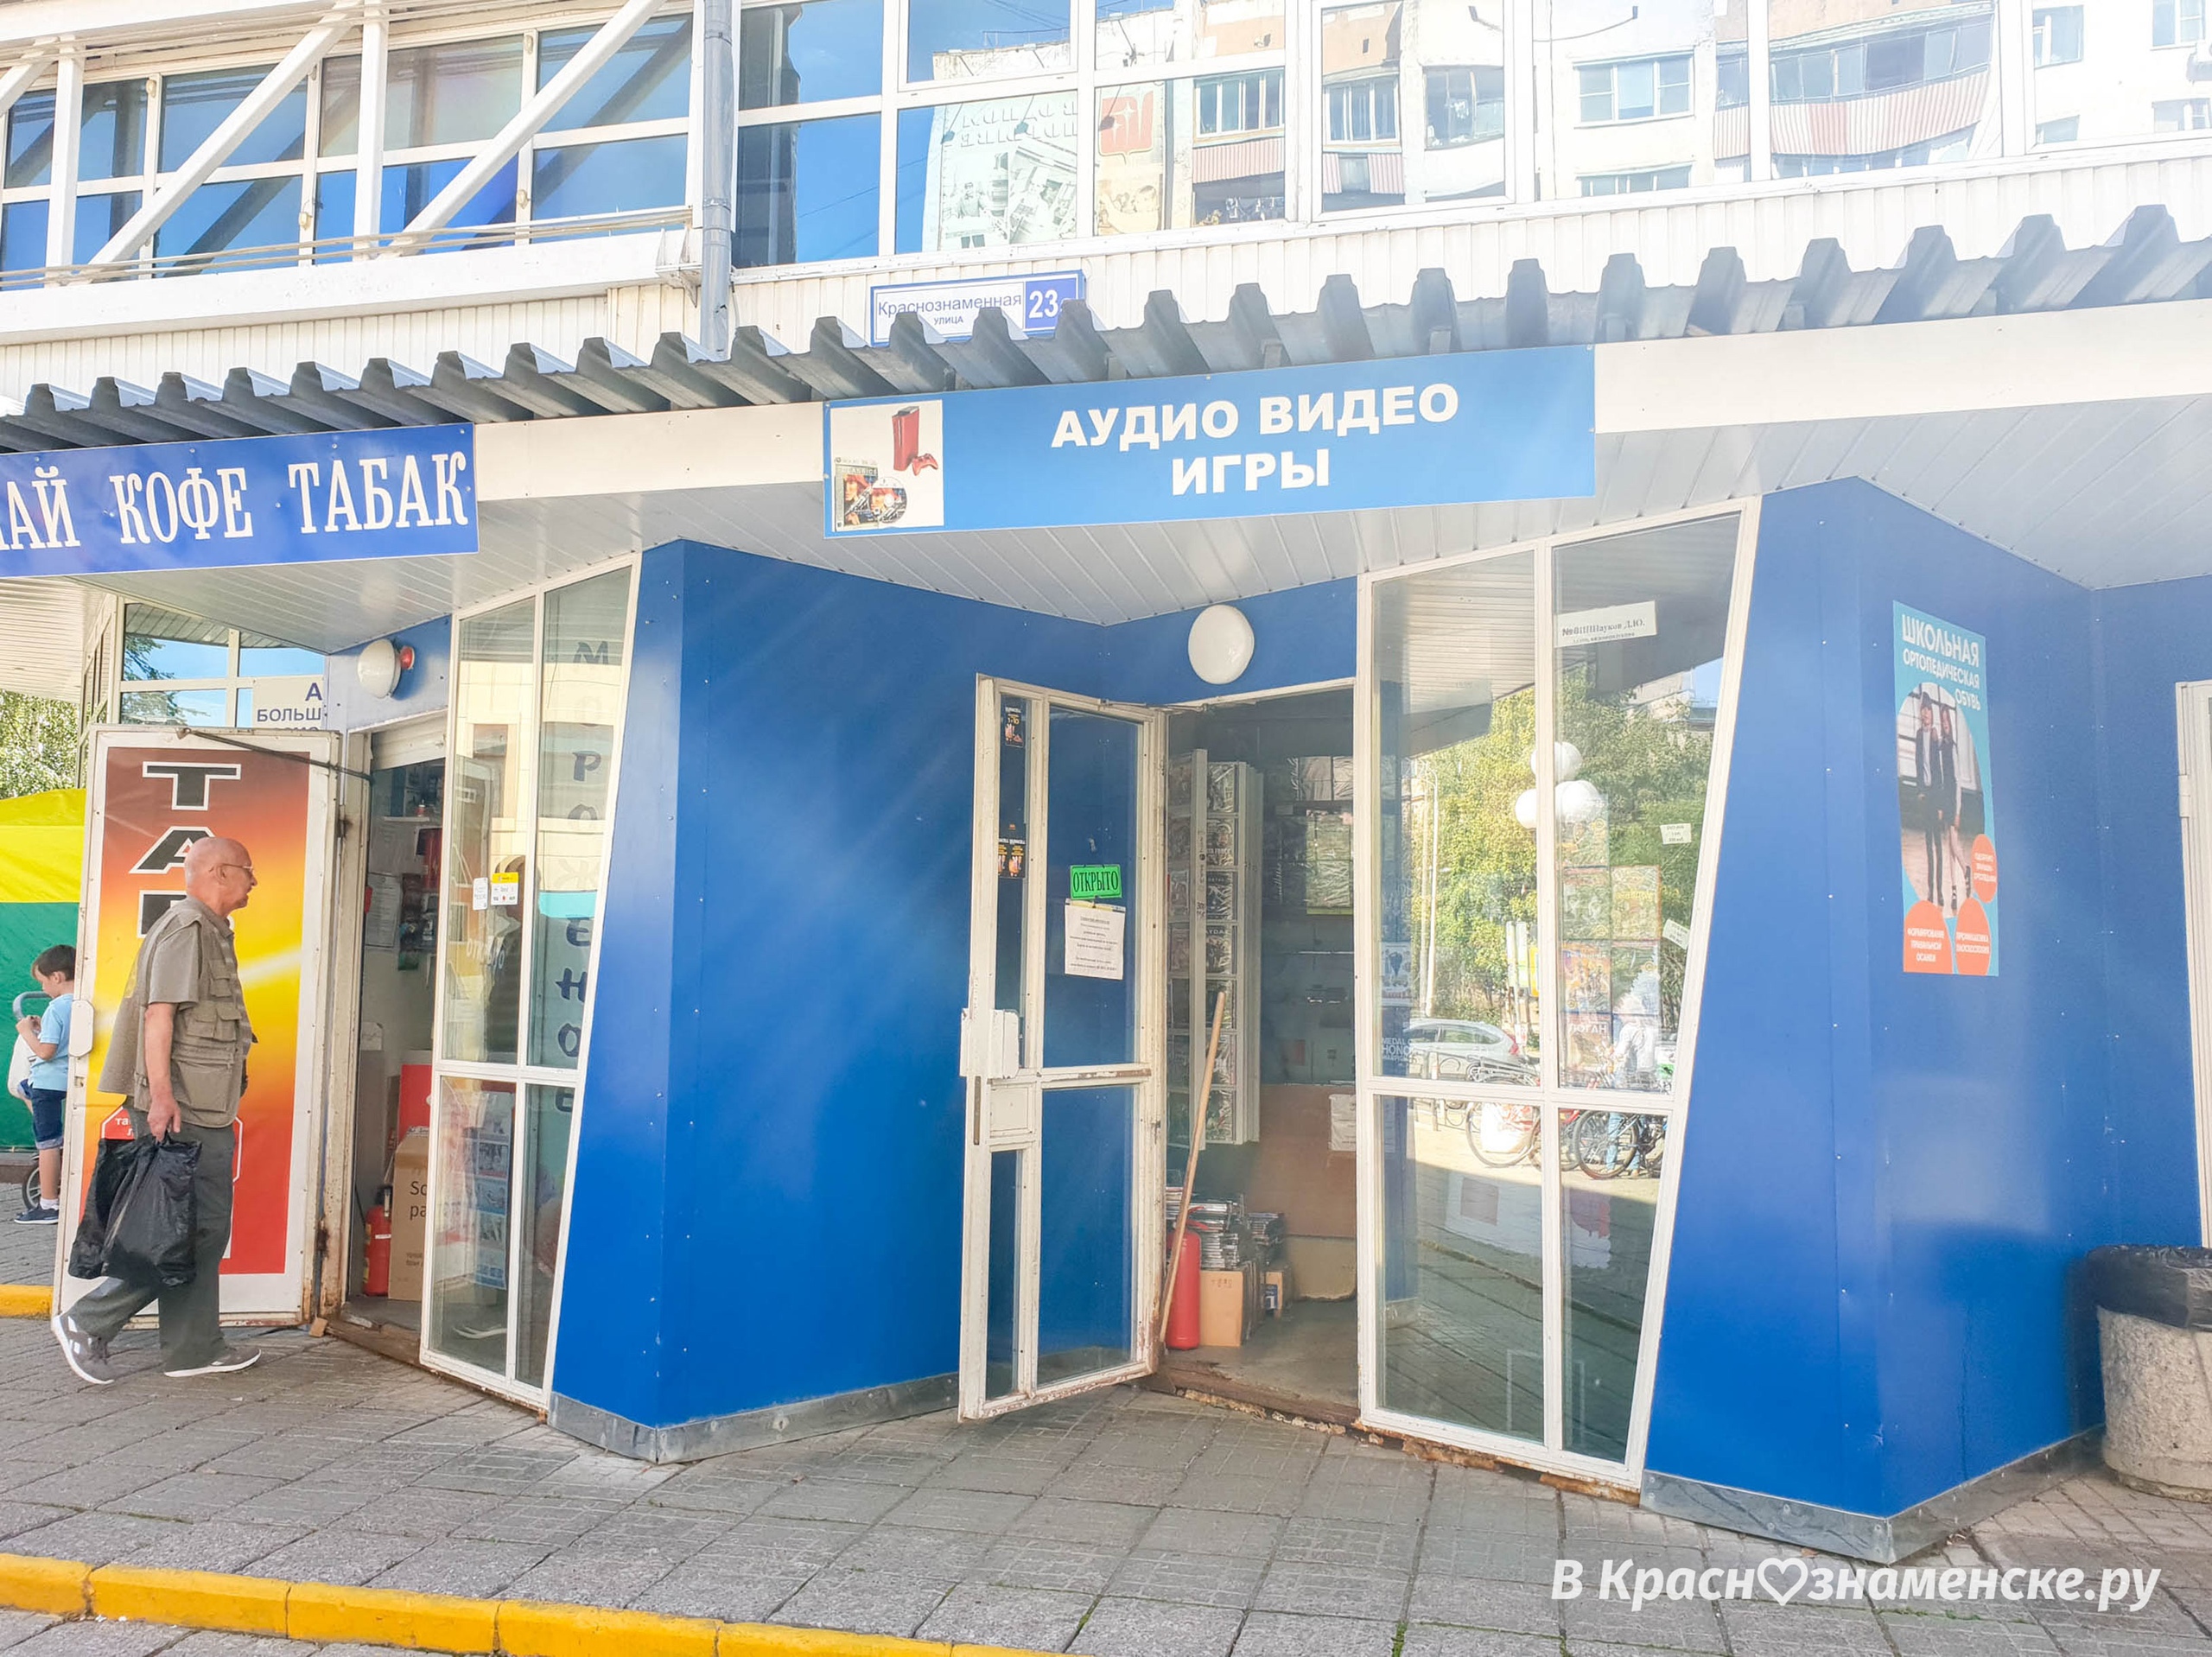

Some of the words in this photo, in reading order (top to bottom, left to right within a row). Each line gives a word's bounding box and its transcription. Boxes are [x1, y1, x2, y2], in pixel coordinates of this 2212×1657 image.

[879, 295, 1022, 317] Краснознаменная
[1028, 289, 1058, 319] 23
[1051, 399, 1238, 452] АУДИО
[1259, 383, 1460, 438] ВИДЕО
[1173, 449, 1331, 496] ИГРЫ
[0, 466, 80, 551] АЙ
[110, 467, 253, 544] КОФЕ
[289, 451, 468, 535] ТАБАК
[1902, 613, 1980, 668] ШКОЛЬНАЯ
[1903, 648, 1980, 689] ОРТОПЕДИЧЕСКАЯ
[1955, 688, 1981, 711] ОБУВЬ
[257, 708, 321, 722] БОЛЬШ
[1072, 869, 1119, 893] ОТКРЫТО
[1382, 1044, 1411, 1055] HONO
